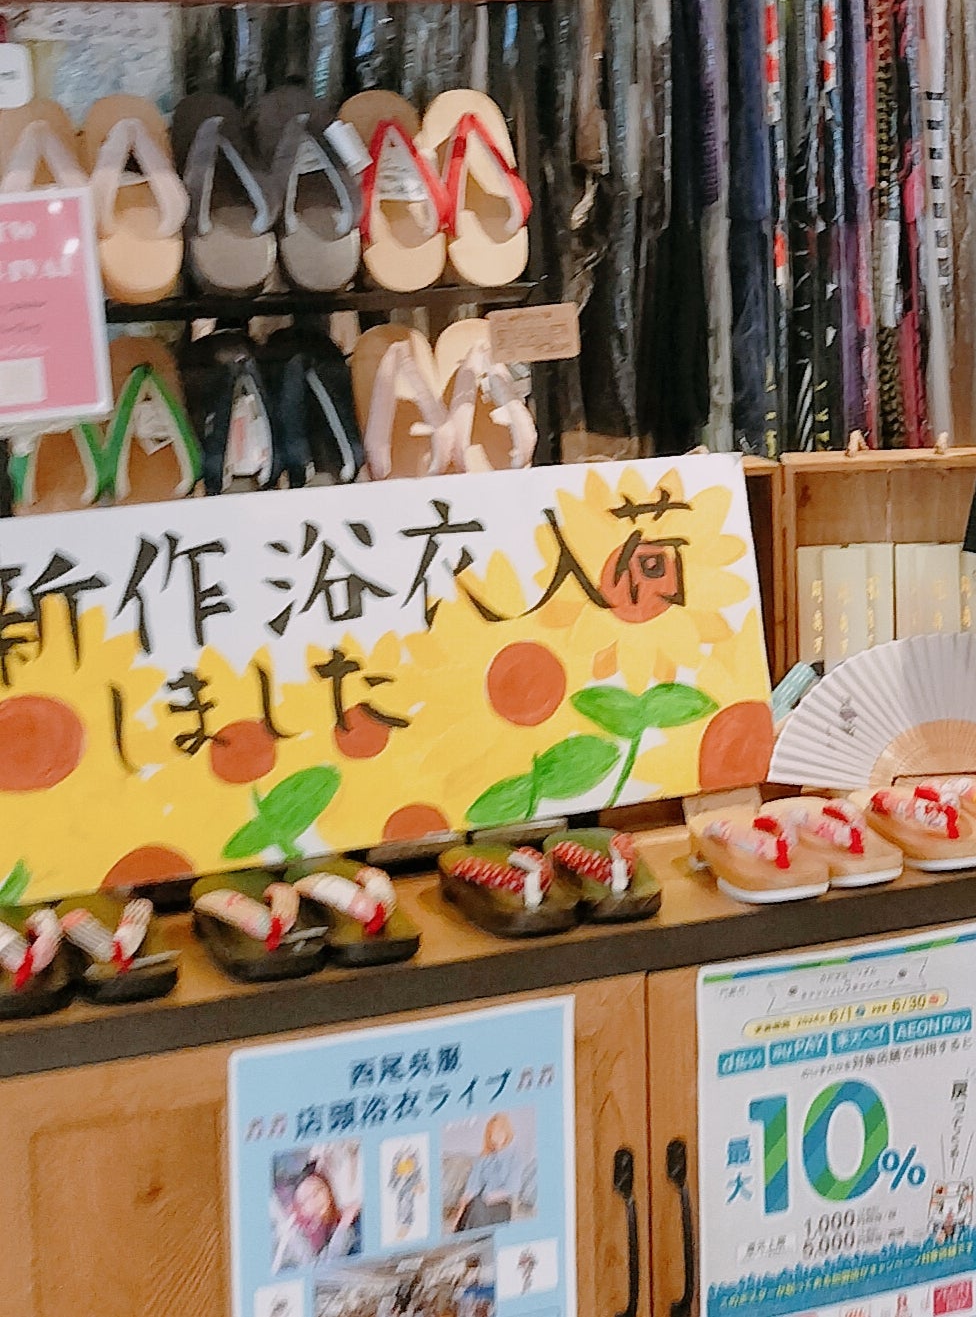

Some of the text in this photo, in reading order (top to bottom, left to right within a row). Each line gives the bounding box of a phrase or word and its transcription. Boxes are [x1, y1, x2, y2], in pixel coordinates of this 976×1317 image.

[111, 647, 409, 773] しました
[726, 1079, 926, 1217] 最大 10%
